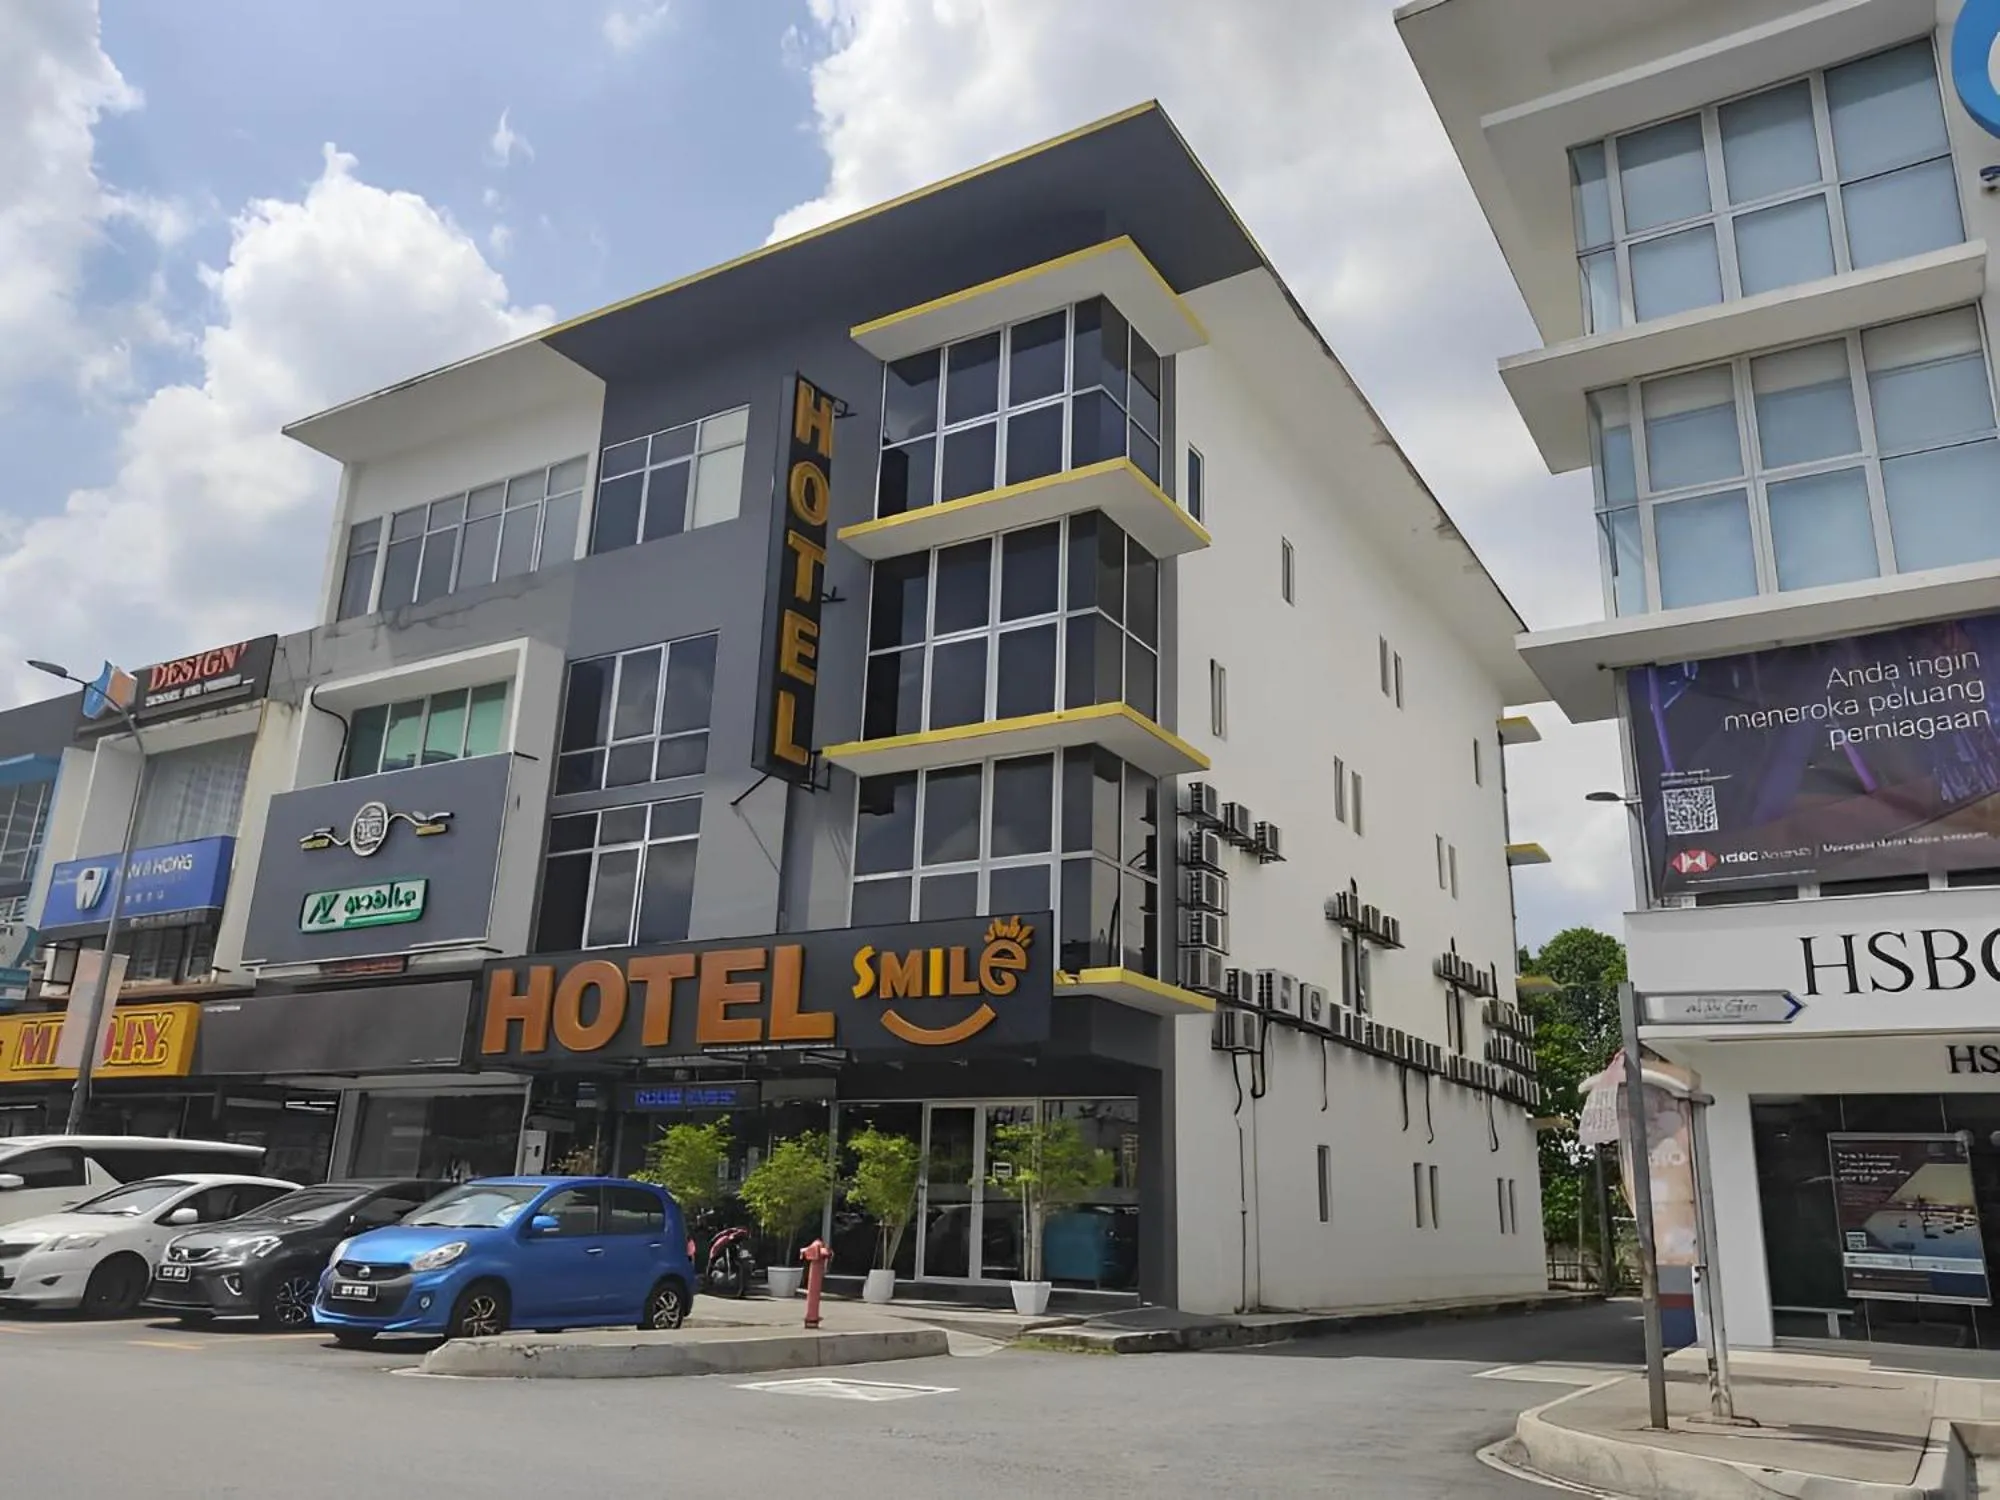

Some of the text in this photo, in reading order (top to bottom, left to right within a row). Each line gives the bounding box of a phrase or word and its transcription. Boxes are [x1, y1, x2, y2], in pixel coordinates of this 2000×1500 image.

[773, 379, 834, 767] HOTEL
[1826, 651, 1980, 689] Anda ingin
[1724, 679, 1986, 731] meneroka peluang
[1829, 709, 1991, 750] perniagaan
[481, 944, 836, 1054] HOTEL
